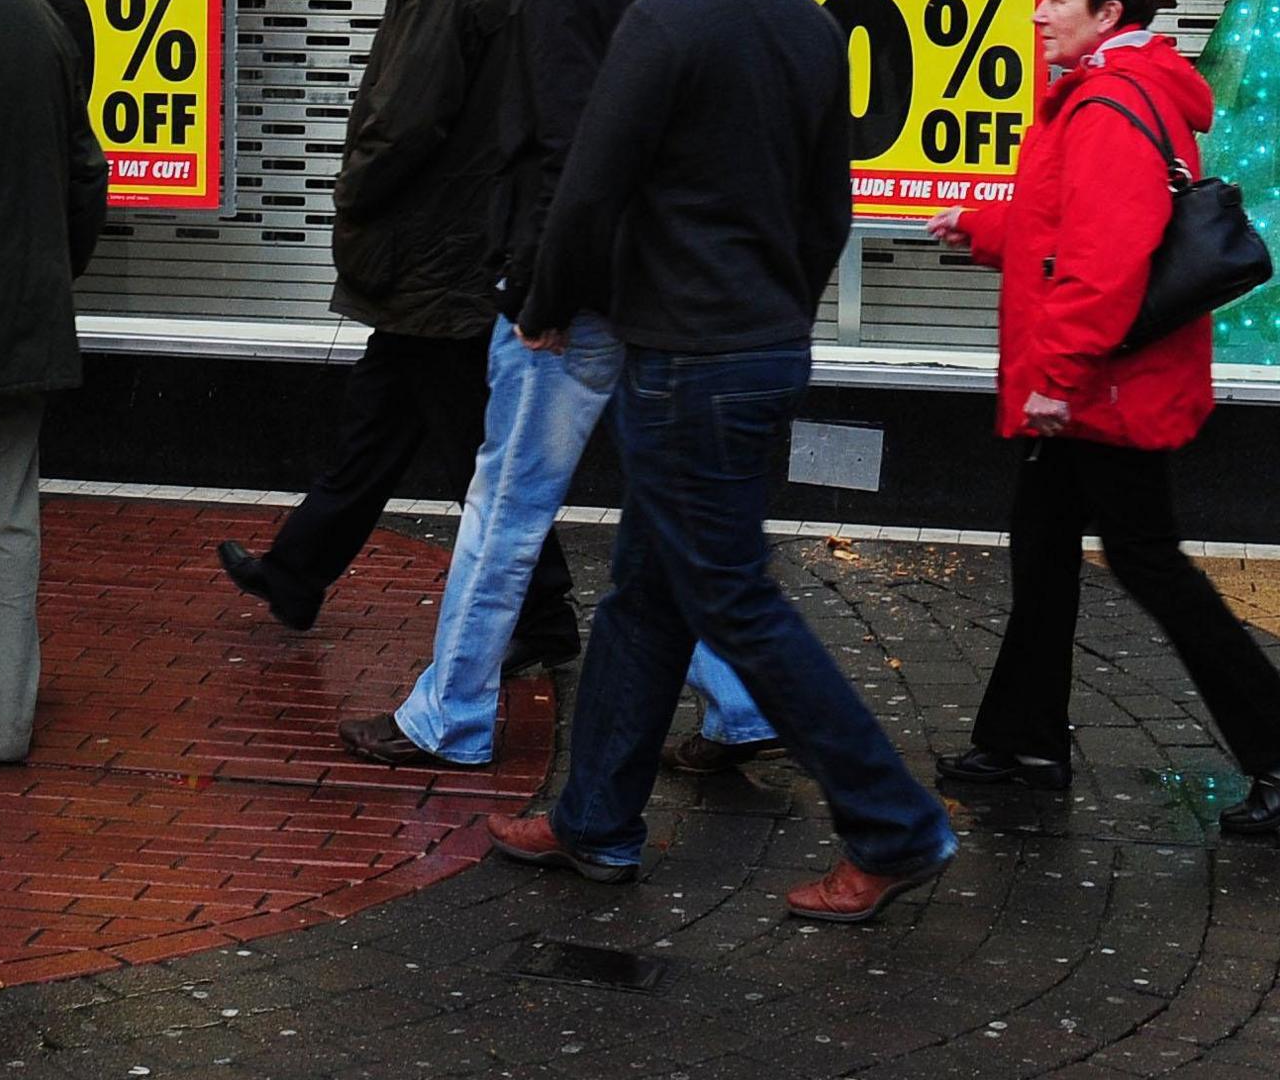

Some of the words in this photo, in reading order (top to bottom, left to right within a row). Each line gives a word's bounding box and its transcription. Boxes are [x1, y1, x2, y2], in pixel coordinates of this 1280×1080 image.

[102, 90, 197, 145] OFF
[920, 108, 1023, 166] OFF
[118, 159, 150, 177] VAT
[151, 160, 191, 179] CUT!
[899, 179, 933, 199] THE
[936, 180, 971, 200] VAT
[973, 182, 1015, 202] CUT!
